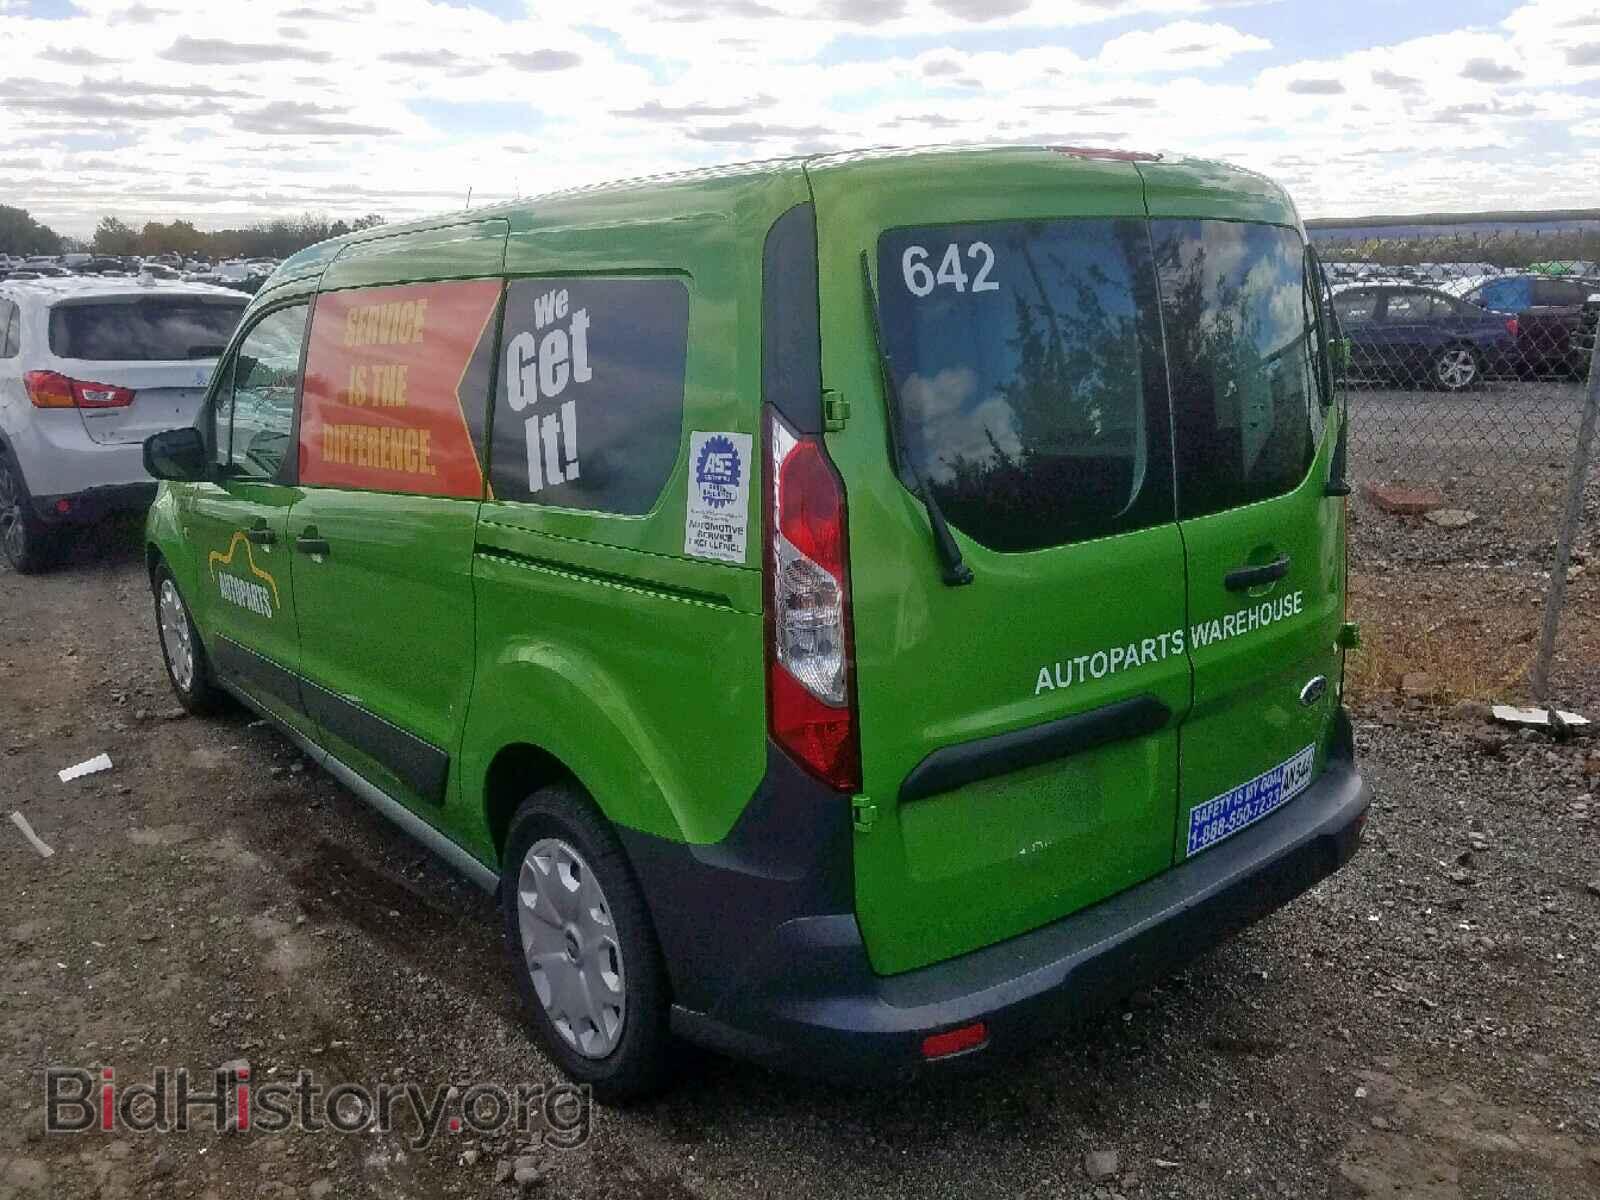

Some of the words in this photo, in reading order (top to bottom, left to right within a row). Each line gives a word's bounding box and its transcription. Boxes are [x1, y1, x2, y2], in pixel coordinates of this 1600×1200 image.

[902, 241, 999, 297] 642
[344, 299, 428, 346] SERVICE
[534, 289, 569, 330] We
[506, 308, 593, 411] Get
[349, 365, 368, 406] IS
[371, 365, 408, 408] THE
[322, 423, 437, 475] DIFFERENCE.
[524, 400, 580, 492] It!
[703, 453, 733, 476] ASE
[688, 519, 744, 536] AUTOMOTIVE
[219, 571, 273, 619] AUTOPARTS
[1034, 628, 1184, 695] AUTOPARTS
[1190, 590, 1304, 650] WAREHOUSE
[1194, 794, 1233, 826] SAFETY
[1234, 788, 1244, 805] IS
[1246, 779, 1260, 801] MY
[1261, 767, 1282, 793] GOAL
